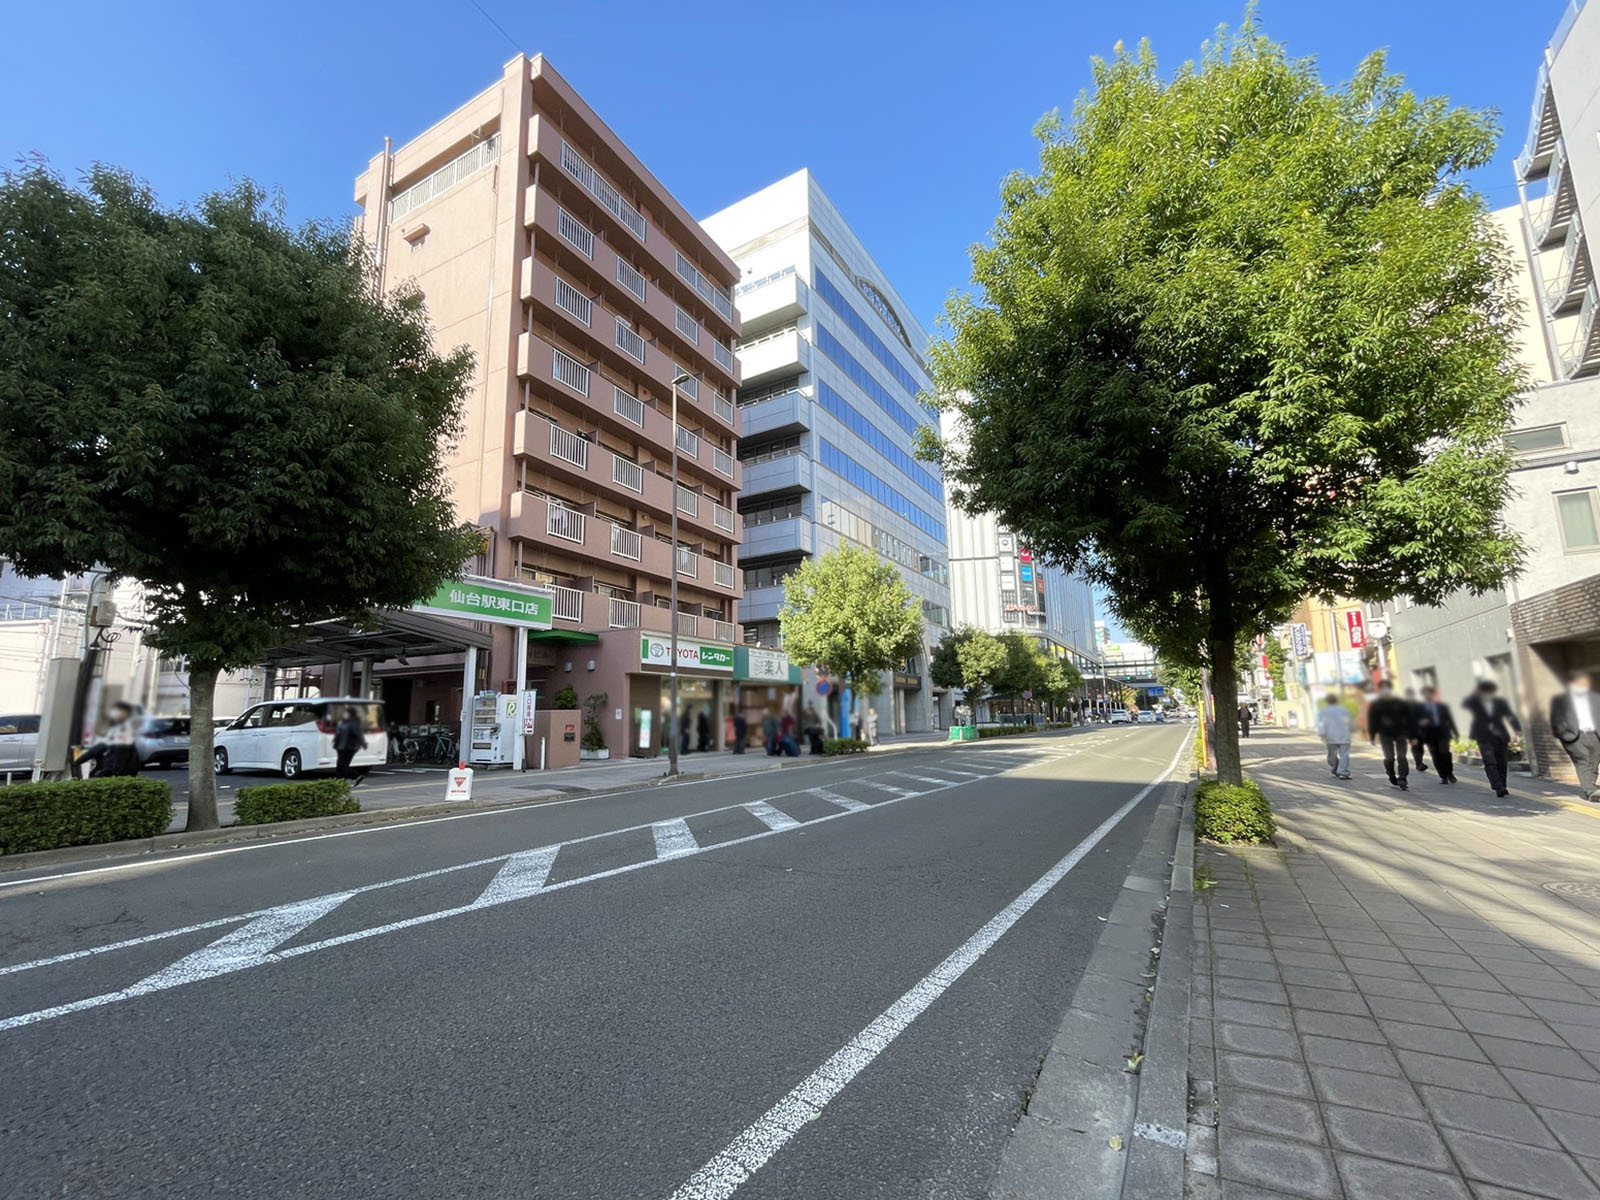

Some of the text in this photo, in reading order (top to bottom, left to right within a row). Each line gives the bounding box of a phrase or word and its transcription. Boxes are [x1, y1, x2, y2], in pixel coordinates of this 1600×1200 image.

[449, 589, 539, 616] 仙台駅東口店
[666, 647, 699, 660] TYOTA
[702, 652, 730, 662] レンタカー
